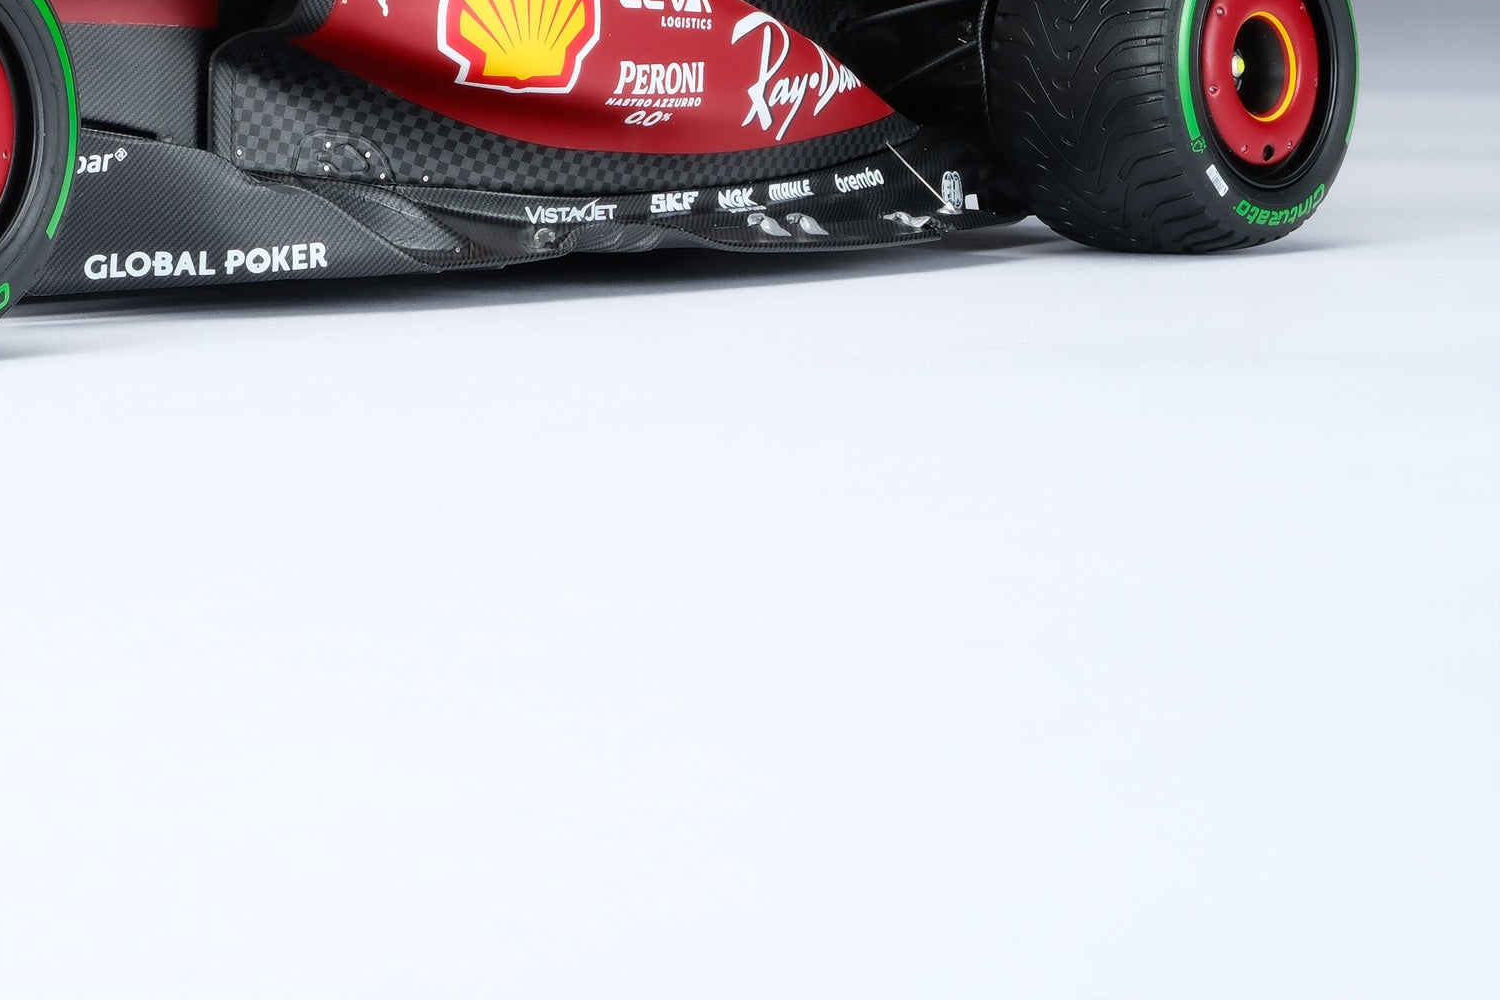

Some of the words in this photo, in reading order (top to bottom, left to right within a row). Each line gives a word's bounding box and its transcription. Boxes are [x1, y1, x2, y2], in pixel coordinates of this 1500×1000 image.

[661, 15, 713, 30] LOGISTICS
[613, 60, 705, 96] PERONI
[605, 97, 653, 108] NASTRO
[653, 96, 702, 108] AZZURRO
[768, 179, 814, 201] MAHLE
[834, 167, 885, 194] brembo
[651, 190, 700, 214] SKF
[717, 187, 759, 209] NGK
[1234, 182, 1326, 226] Cinturato
[83, 251, 216, 281] GLOBAL
[224, 241, 328, 275] POKER
